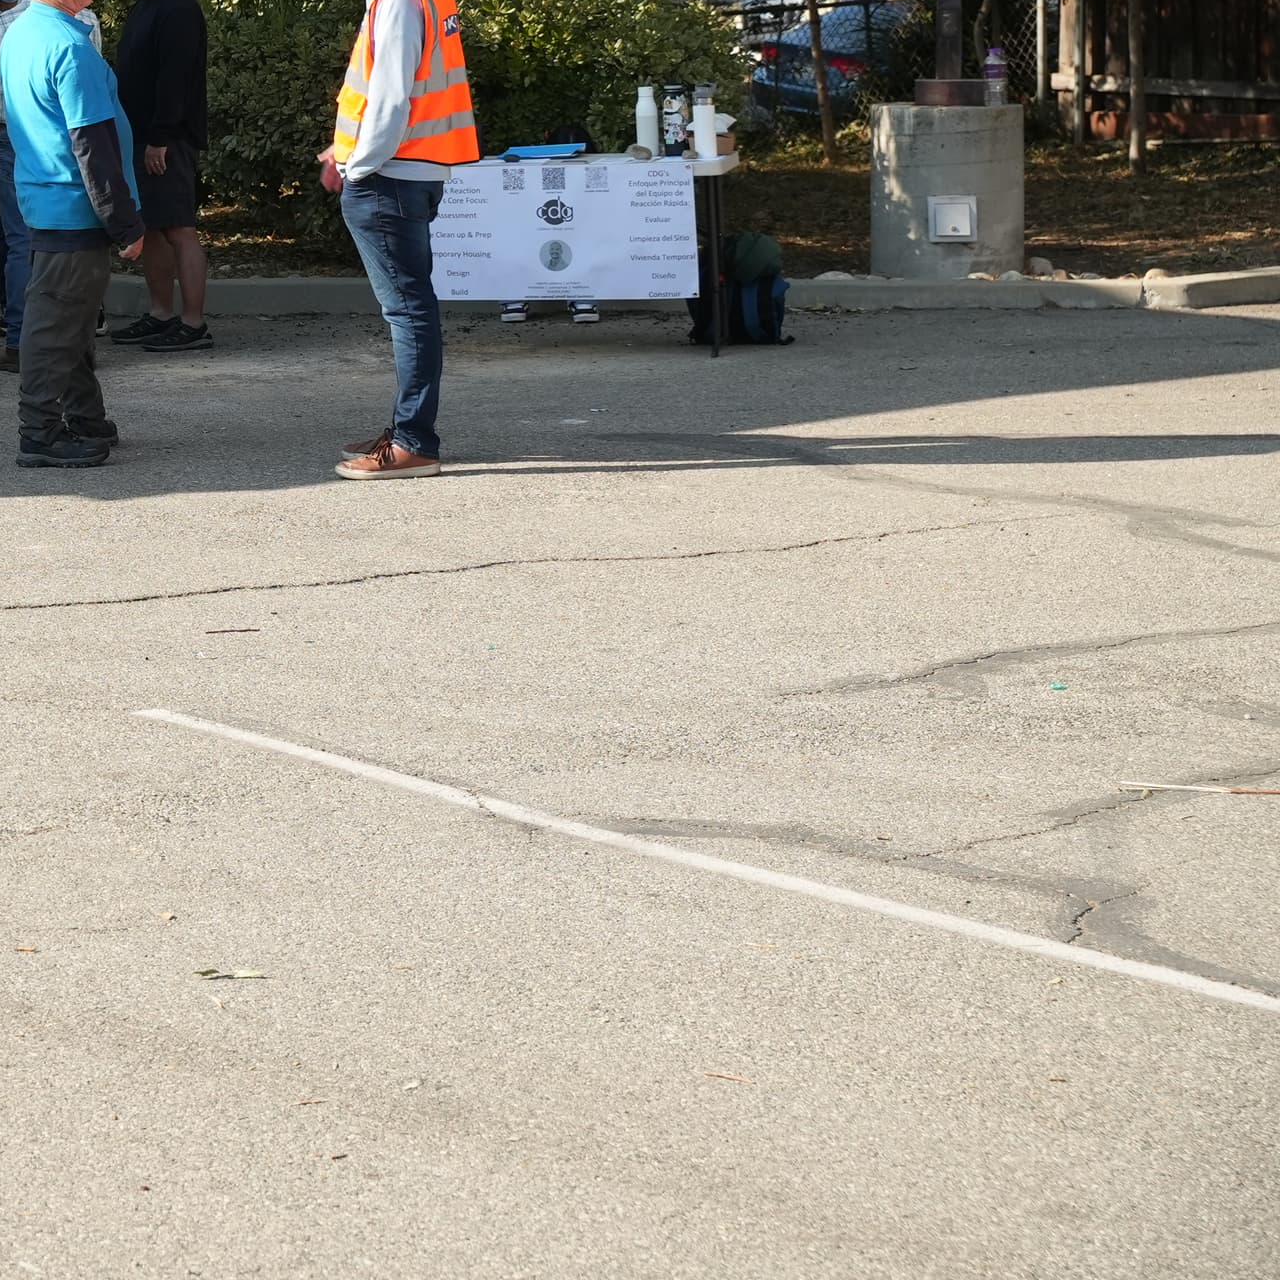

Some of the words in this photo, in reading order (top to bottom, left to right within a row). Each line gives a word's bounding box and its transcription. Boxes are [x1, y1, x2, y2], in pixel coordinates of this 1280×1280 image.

[648, 169, 670, 177] CDG's
[628, 180, 658, 188] Enfoque
[660, 179, 690, 187] Principal
[450, 186, 481, 195] Reaction
[635, 190, 647, 198] del
[648, 190, 674, 198] Equipo
[675, 189, 684, 197] de
[448, 197, 465, 205] Core
[466, 197, 489, 205] Focus:
[630, 199, 662, 208] Reacción
[536, 195, 574, 223] cdg
[644, 216, 672, 224] Evaluar
[435, 231, 455, 239] Clean
[457, 232, 466, 240] up
[467, 231, 473, 239] &
[475, 231, 492, 240] Prep
[629, 235, 660, 243] Limpieza
[661, 234, 673, 242] del
[674, 234, 690, 242] Sitio
[431, 251, 461, 259] mporary
[462, 250, 492, 259] Housing
[630, 253, 660, 261] Vivienda
[661, 253, 696, 262] Temporal
[446, 269, 470, 278] Design
[651, 272, 677, 280] Diseño
[451, 288, 469, 296] Build
